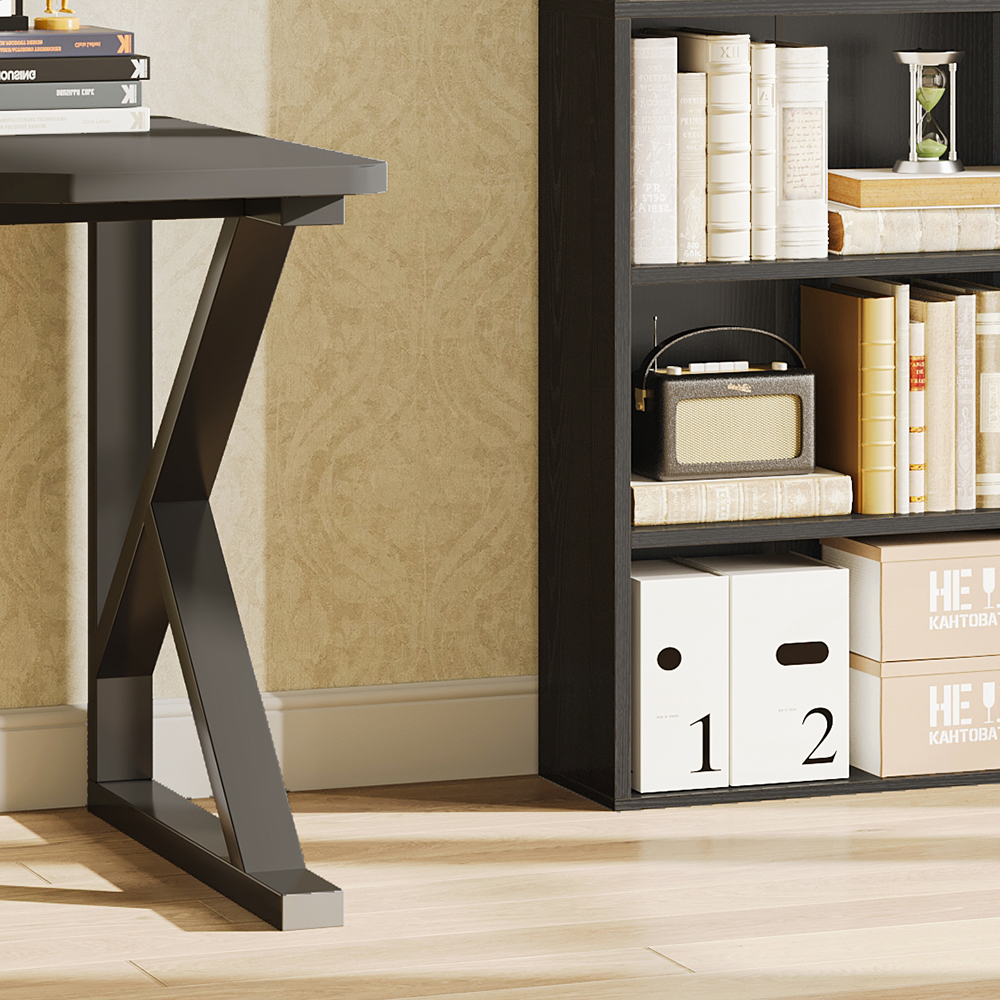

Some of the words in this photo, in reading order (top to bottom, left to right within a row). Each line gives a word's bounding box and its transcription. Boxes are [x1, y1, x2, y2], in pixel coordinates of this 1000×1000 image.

[720, 46, 740, 59] XII
[643, 183, 661, 193] PR
[642, 194, 666, 202] 5790
[801, 706, 839, 766] 2
[689, 713, 723, 774] 1
